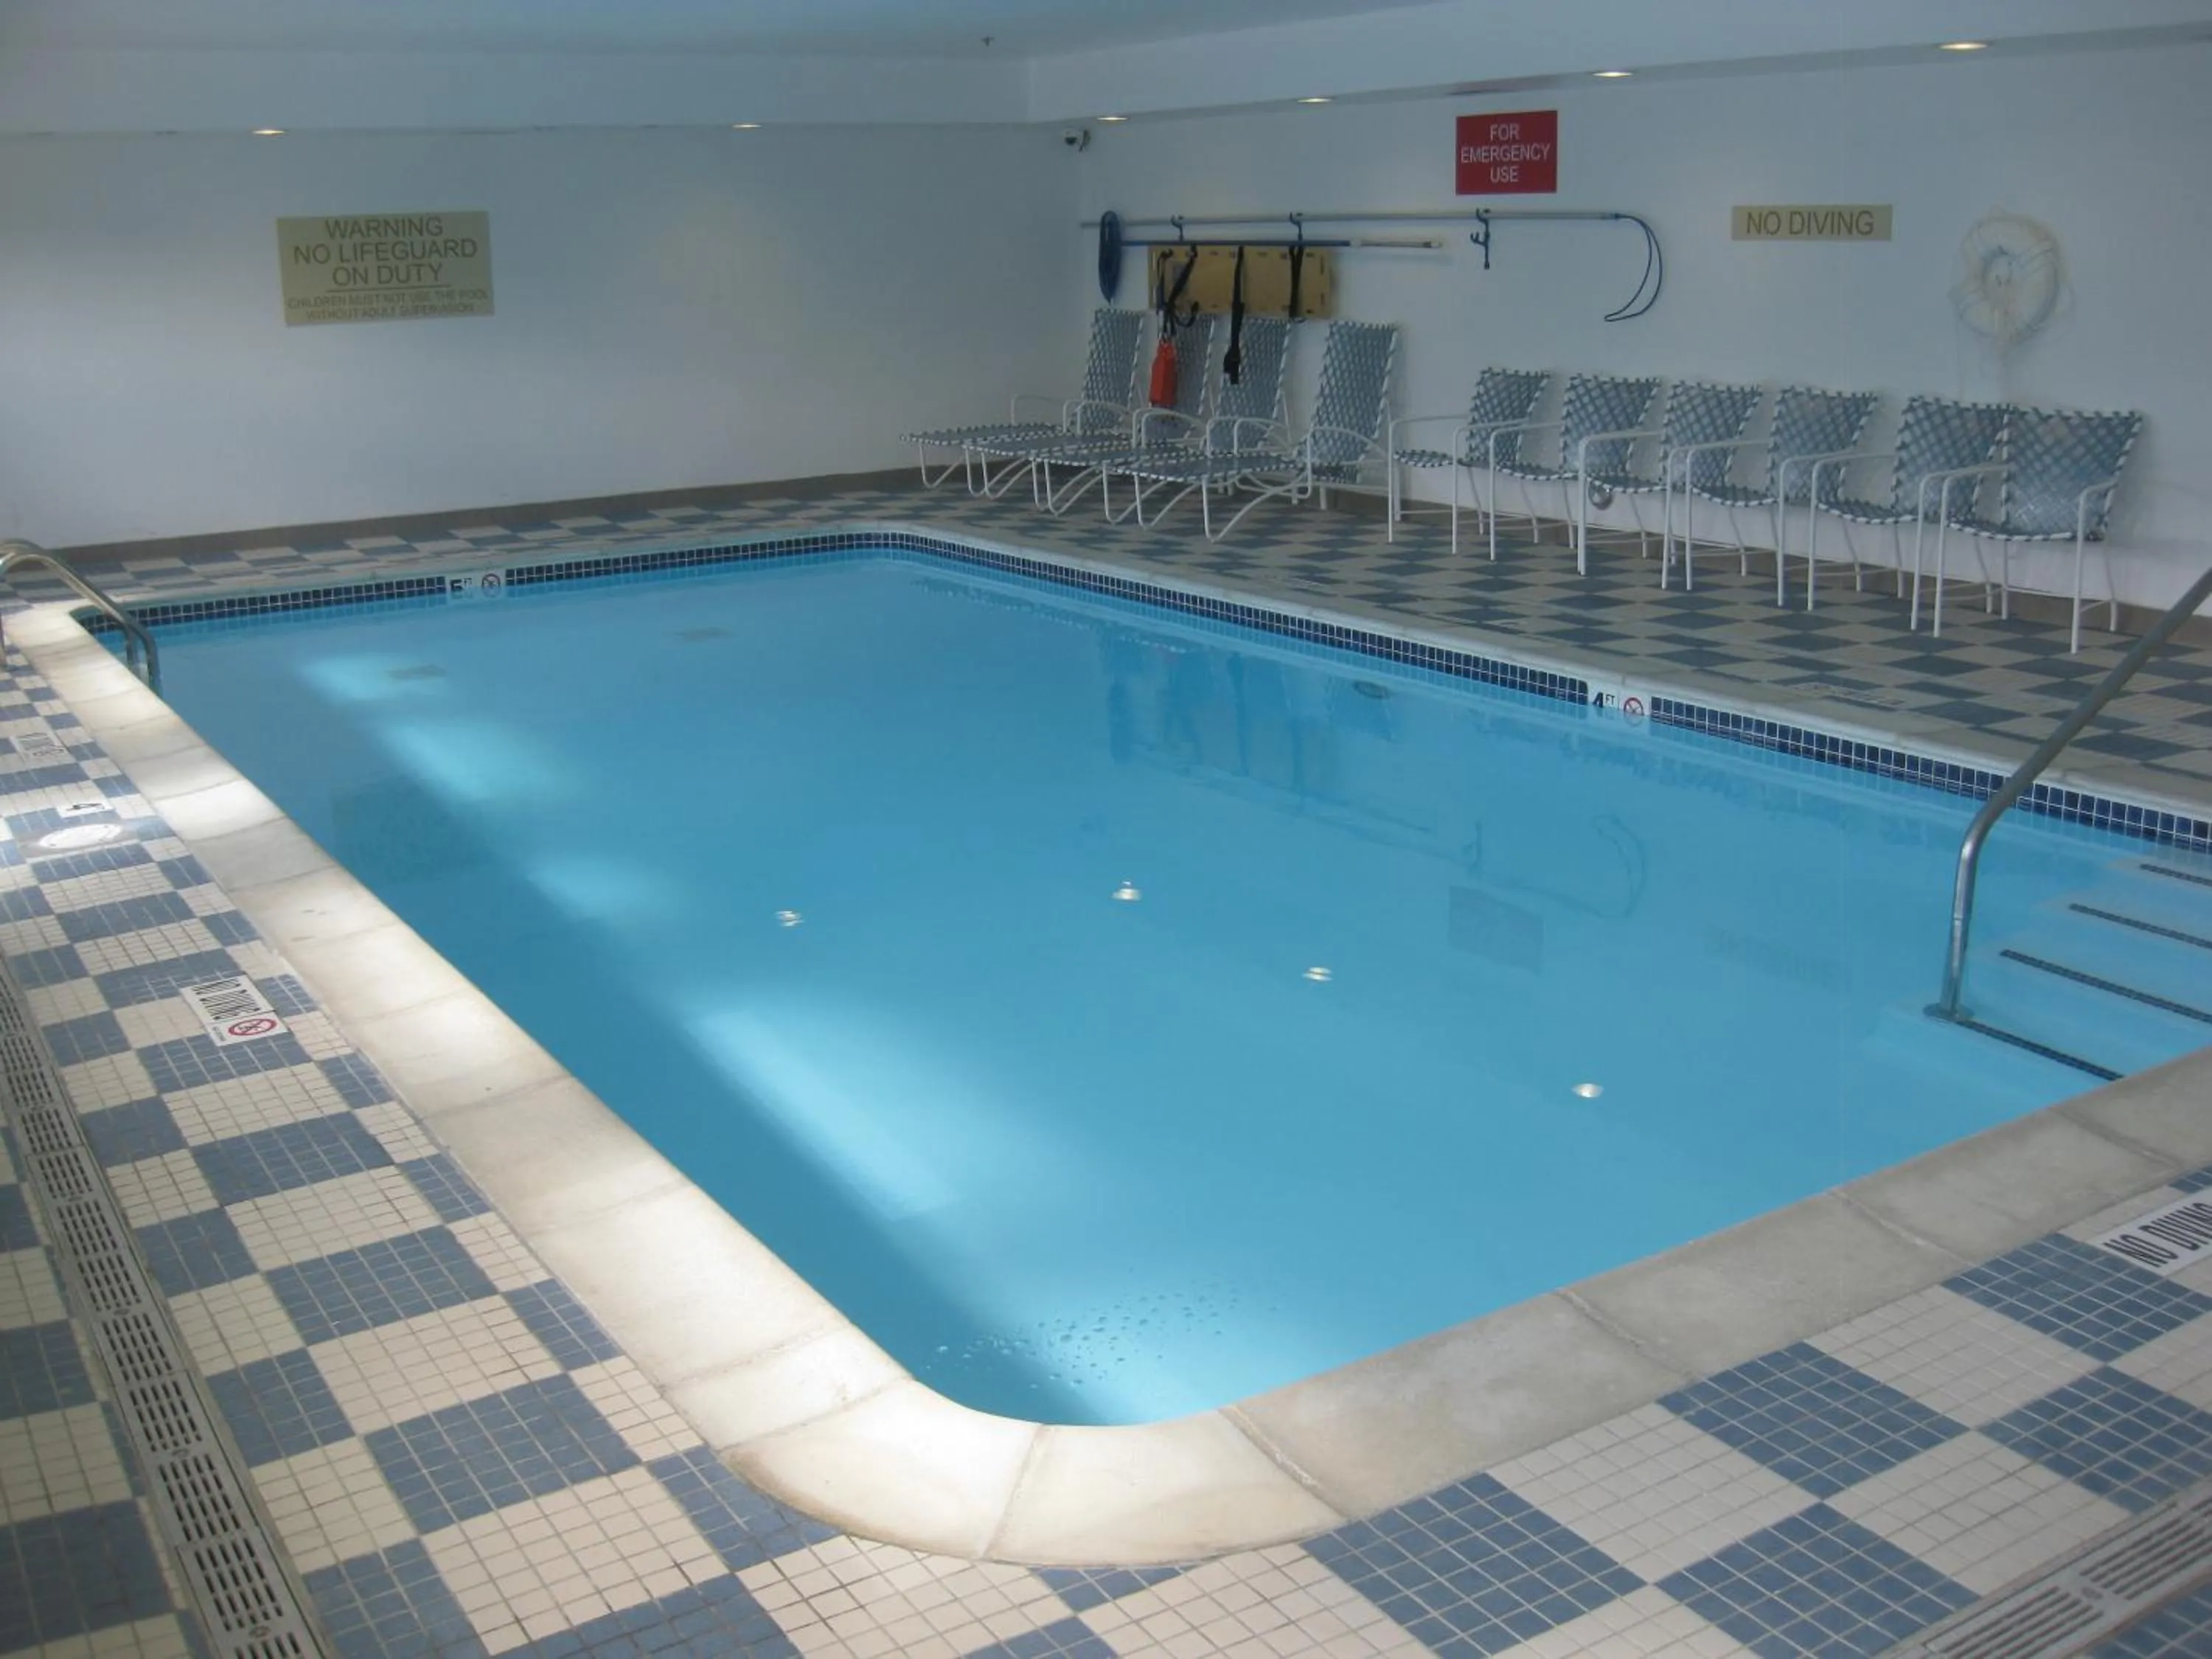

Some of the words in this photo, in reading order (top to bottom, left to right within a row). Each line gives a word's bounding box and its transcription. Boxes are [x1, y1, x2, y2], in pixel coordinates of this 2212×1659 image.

[1490, 123, 1520, 141] FOR
[1461, 143, 1551, 163] EMERGENCY
[1490, 166, 1520, 183] USE
[324, 216, 443, 240] WARNING
[1747, 211, 1781, 235] NO
[1789, 209, 1874, 235] DIVING
[293, 243, 330, 265] NO
[339, 238, 478, 263] LIFEGUARD
[332, 265, 368, 286] ON
[378, 263, 442, 285] DUTY
[288, 296, 347, 309] CHILDREN
[1593, 692, 1604, 709] 4
[1605, 694, 1615, 706] FT
[191, 978, 241, 995] NO
[199, 989, 261, 1021] DIVING
[2102, 1234, 2179, 1268] NO
